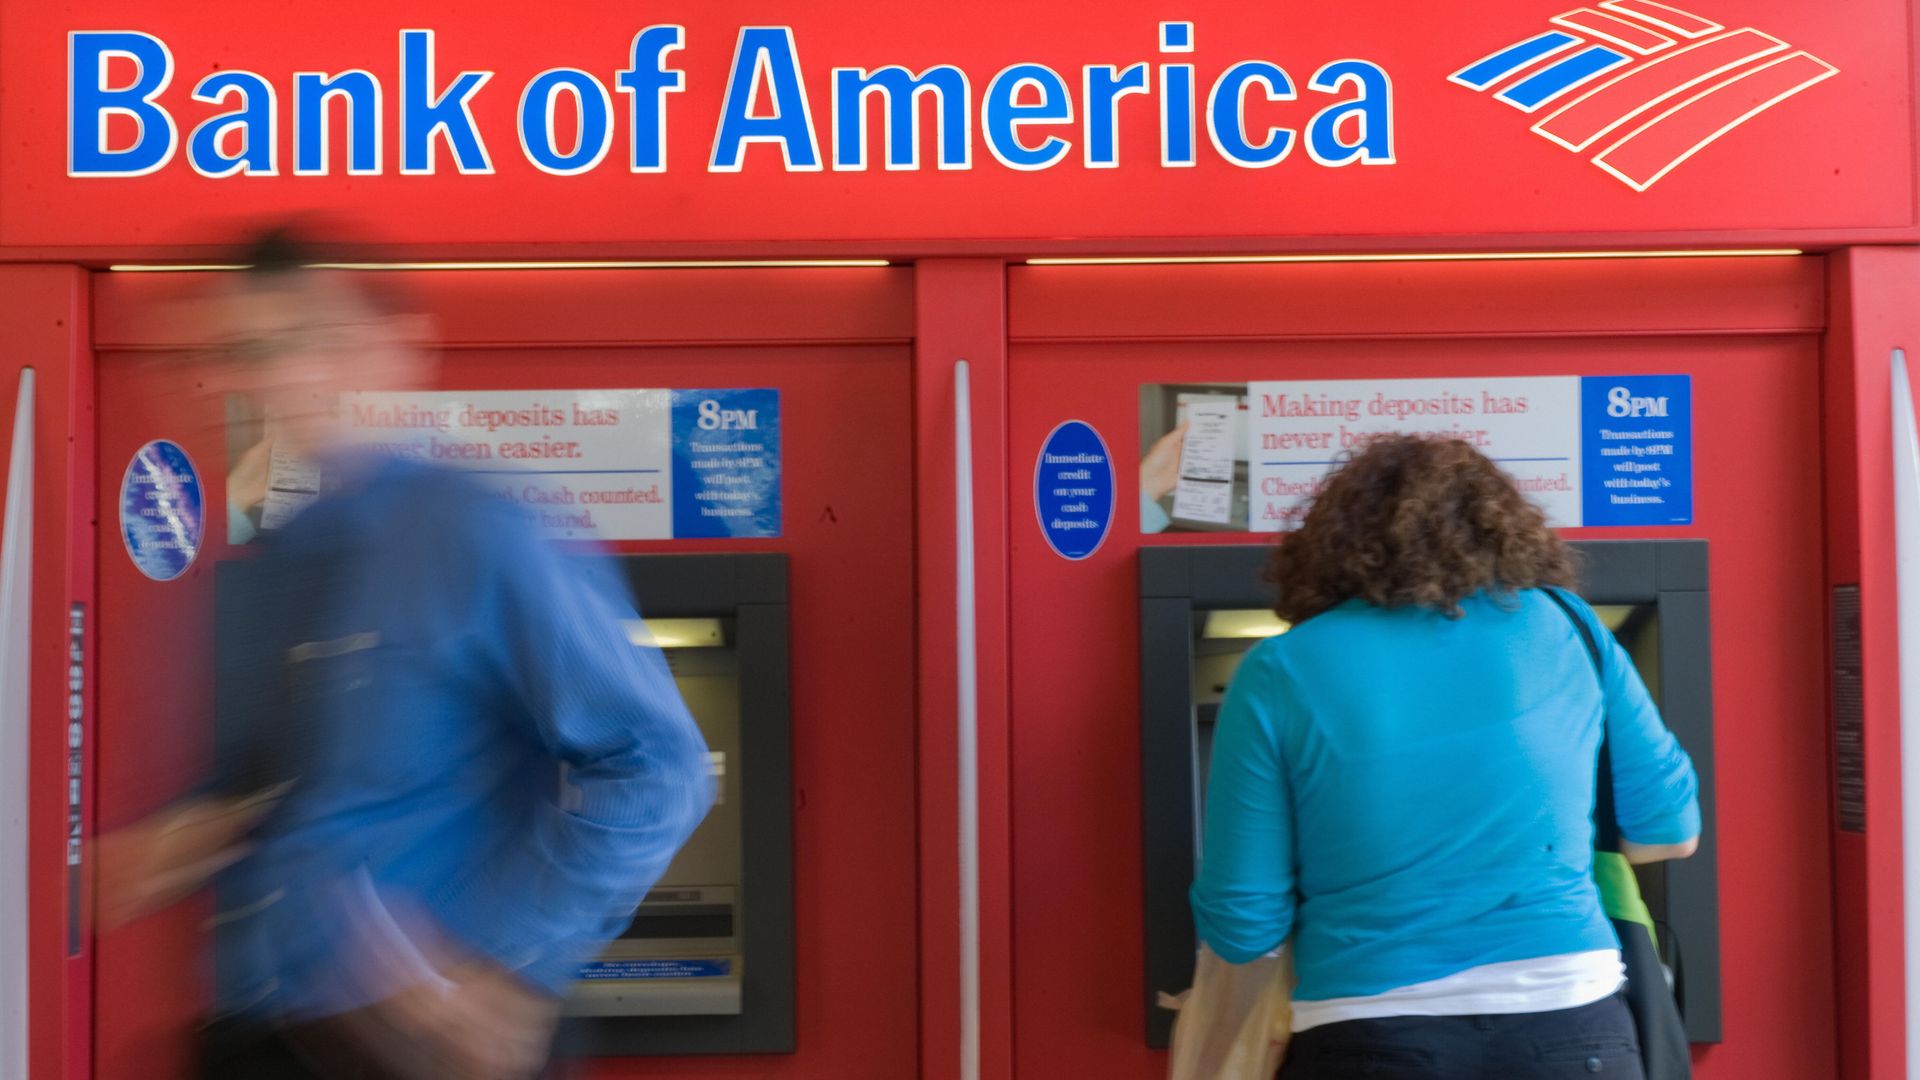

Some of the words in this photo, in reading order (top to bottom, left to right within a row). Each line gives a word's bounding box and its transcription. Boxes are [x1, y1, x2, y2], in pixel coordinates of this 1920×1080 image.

[67, 28, 496, 178] Bank
[517, 24, 686, 176] of
[707, 21, 1396, 172] America
[1261, 393, 1361, 421] Making
[1367, 391, 1474, 421] deposits
[1481, 390, 1529, 414] has
[1607, 386, 1670, 417] 8PM
[351, 404, 450, 432] Making
[458, 403, 566, 432] deposits
[572, 403, 620, 426] has
[697, 399, 758, 430] 8PM
[1262, 429, 1333, 450] never
[1599, 429, 1675, 440] Transactions
[429, 437, 492, 459] been
[499, 435, 583, 458] easier.
[689, 441, 763, 453] Transactions
[1600, 445, 1630, 456] made
[1045, 453, 1105, 464] Immediate
[1612, 461, 1633, 472] will
[1058, 469, 1091, 480] credit
[1603, 477, 1629, 488] with
[522, 484, 575, 504] Cash
[579, 486, 664, 504] counted.
[1053, 487, 1067, 496] on
[1068, 488, 1096, 498] your
[1610, 494, 1665, 505] business.
[1061, 502, 1088, 512] cash
[1051, 518, 1099, 530] deposits
